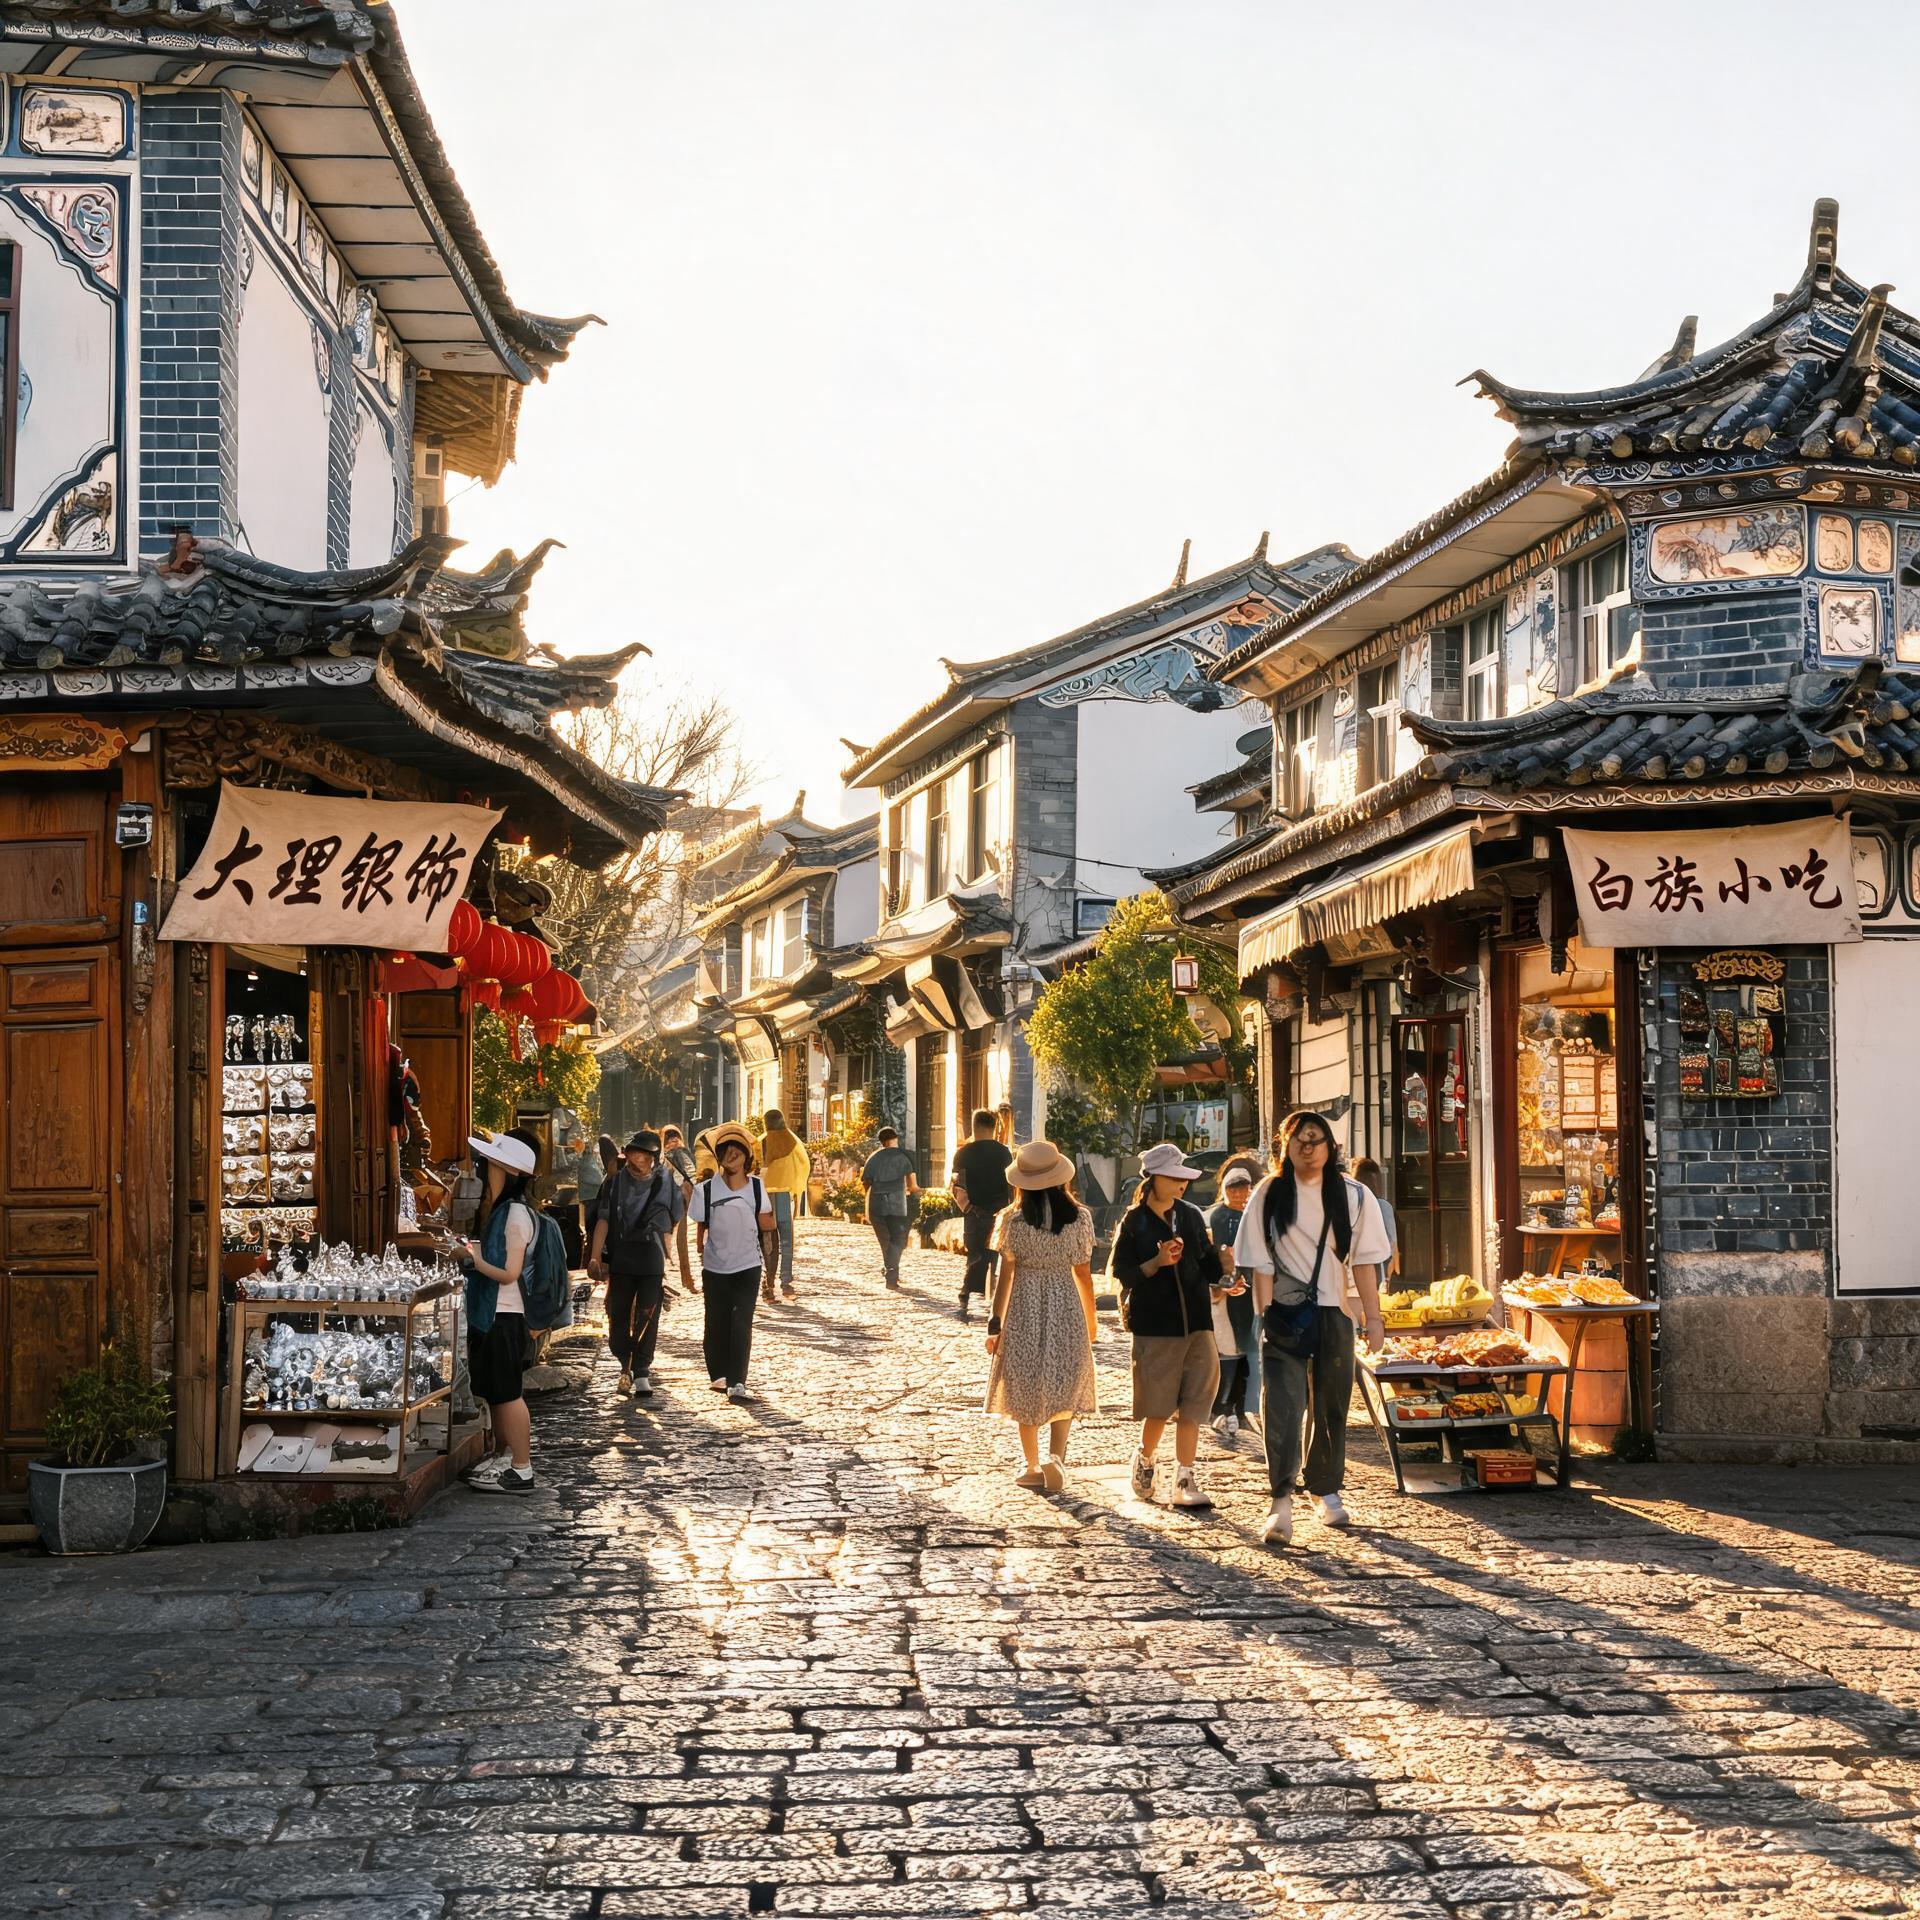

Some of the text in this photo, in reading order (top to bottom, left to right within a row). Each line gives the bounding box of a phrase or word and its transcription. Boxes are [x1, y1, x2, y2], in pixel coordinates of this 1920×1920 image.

[193, 826, 467, 922] 大理银饰
[1588, 848, 1843, 913] 白族小吃
